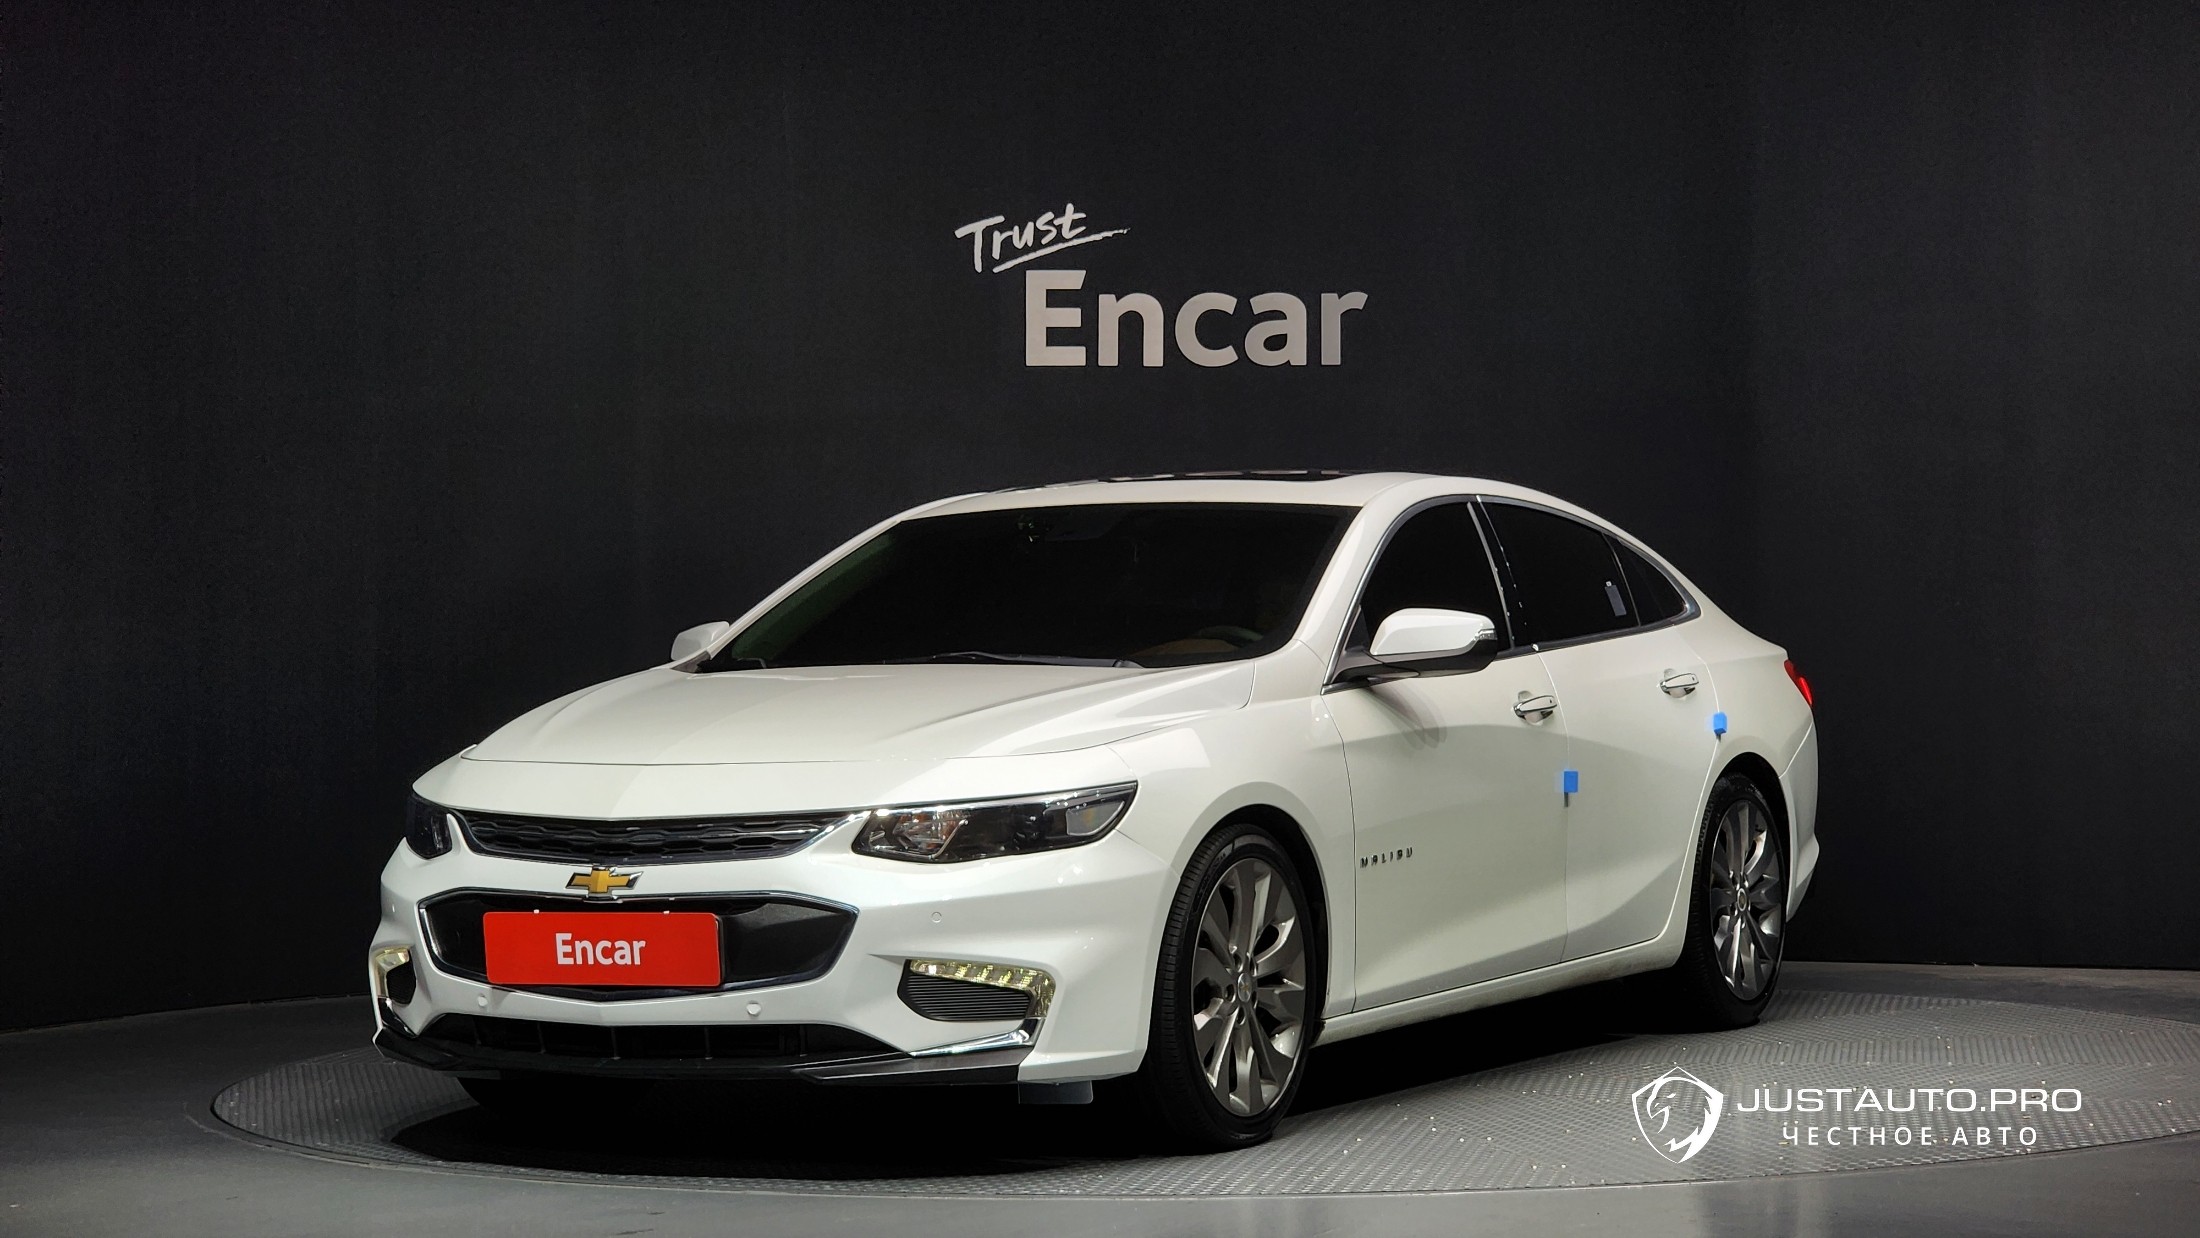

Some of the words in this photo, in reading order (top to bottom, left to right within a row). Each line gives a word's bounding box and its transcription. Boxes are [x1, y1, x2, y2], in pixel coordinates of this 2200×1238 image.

[954, 203, 1087, 273] Trust
[1025, 269, 1369, 367] Encar
[1360, 847, 1413, 868] MALIBU
[555, 932, 646, 965] Encar
